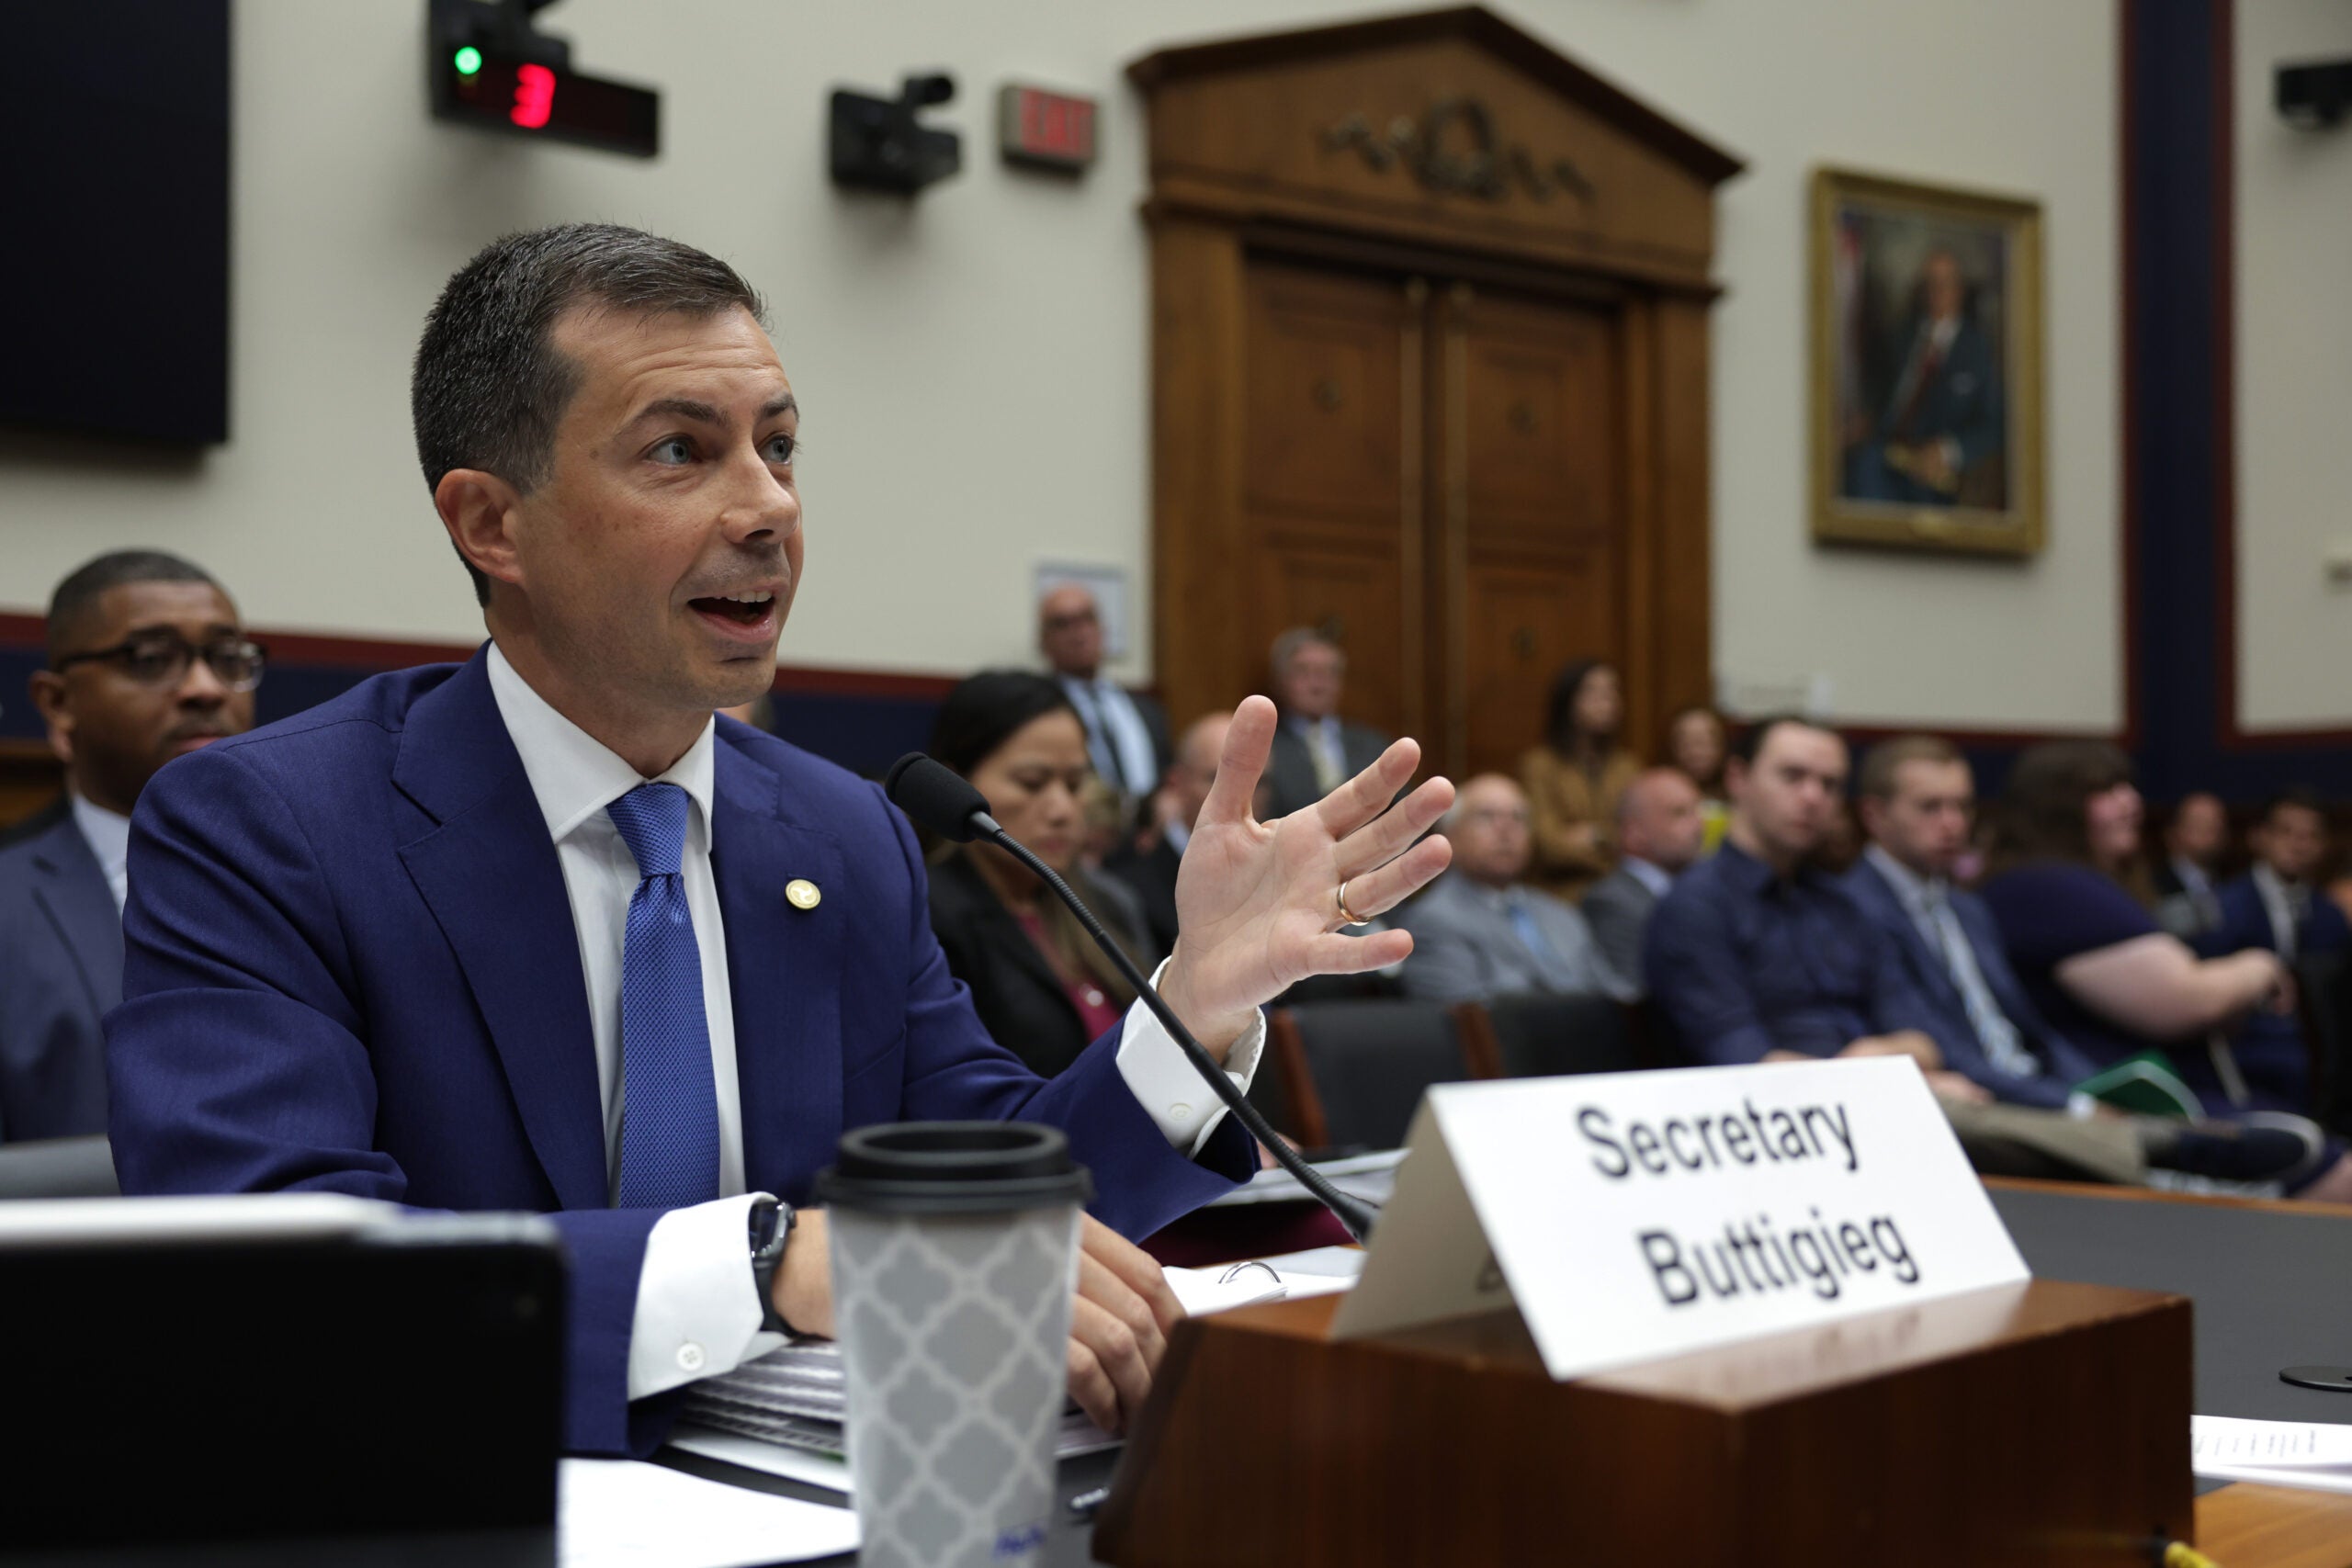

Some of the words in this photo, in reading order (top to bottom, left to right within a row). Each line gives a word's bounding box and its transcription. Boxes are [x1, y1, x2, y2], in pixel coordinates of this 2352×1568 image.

[511, 62, 556, 129] 3
[1576, 1099, 1859, 1179] Secretary
[1637, 1206, 1920, 1305] Buttigieg
